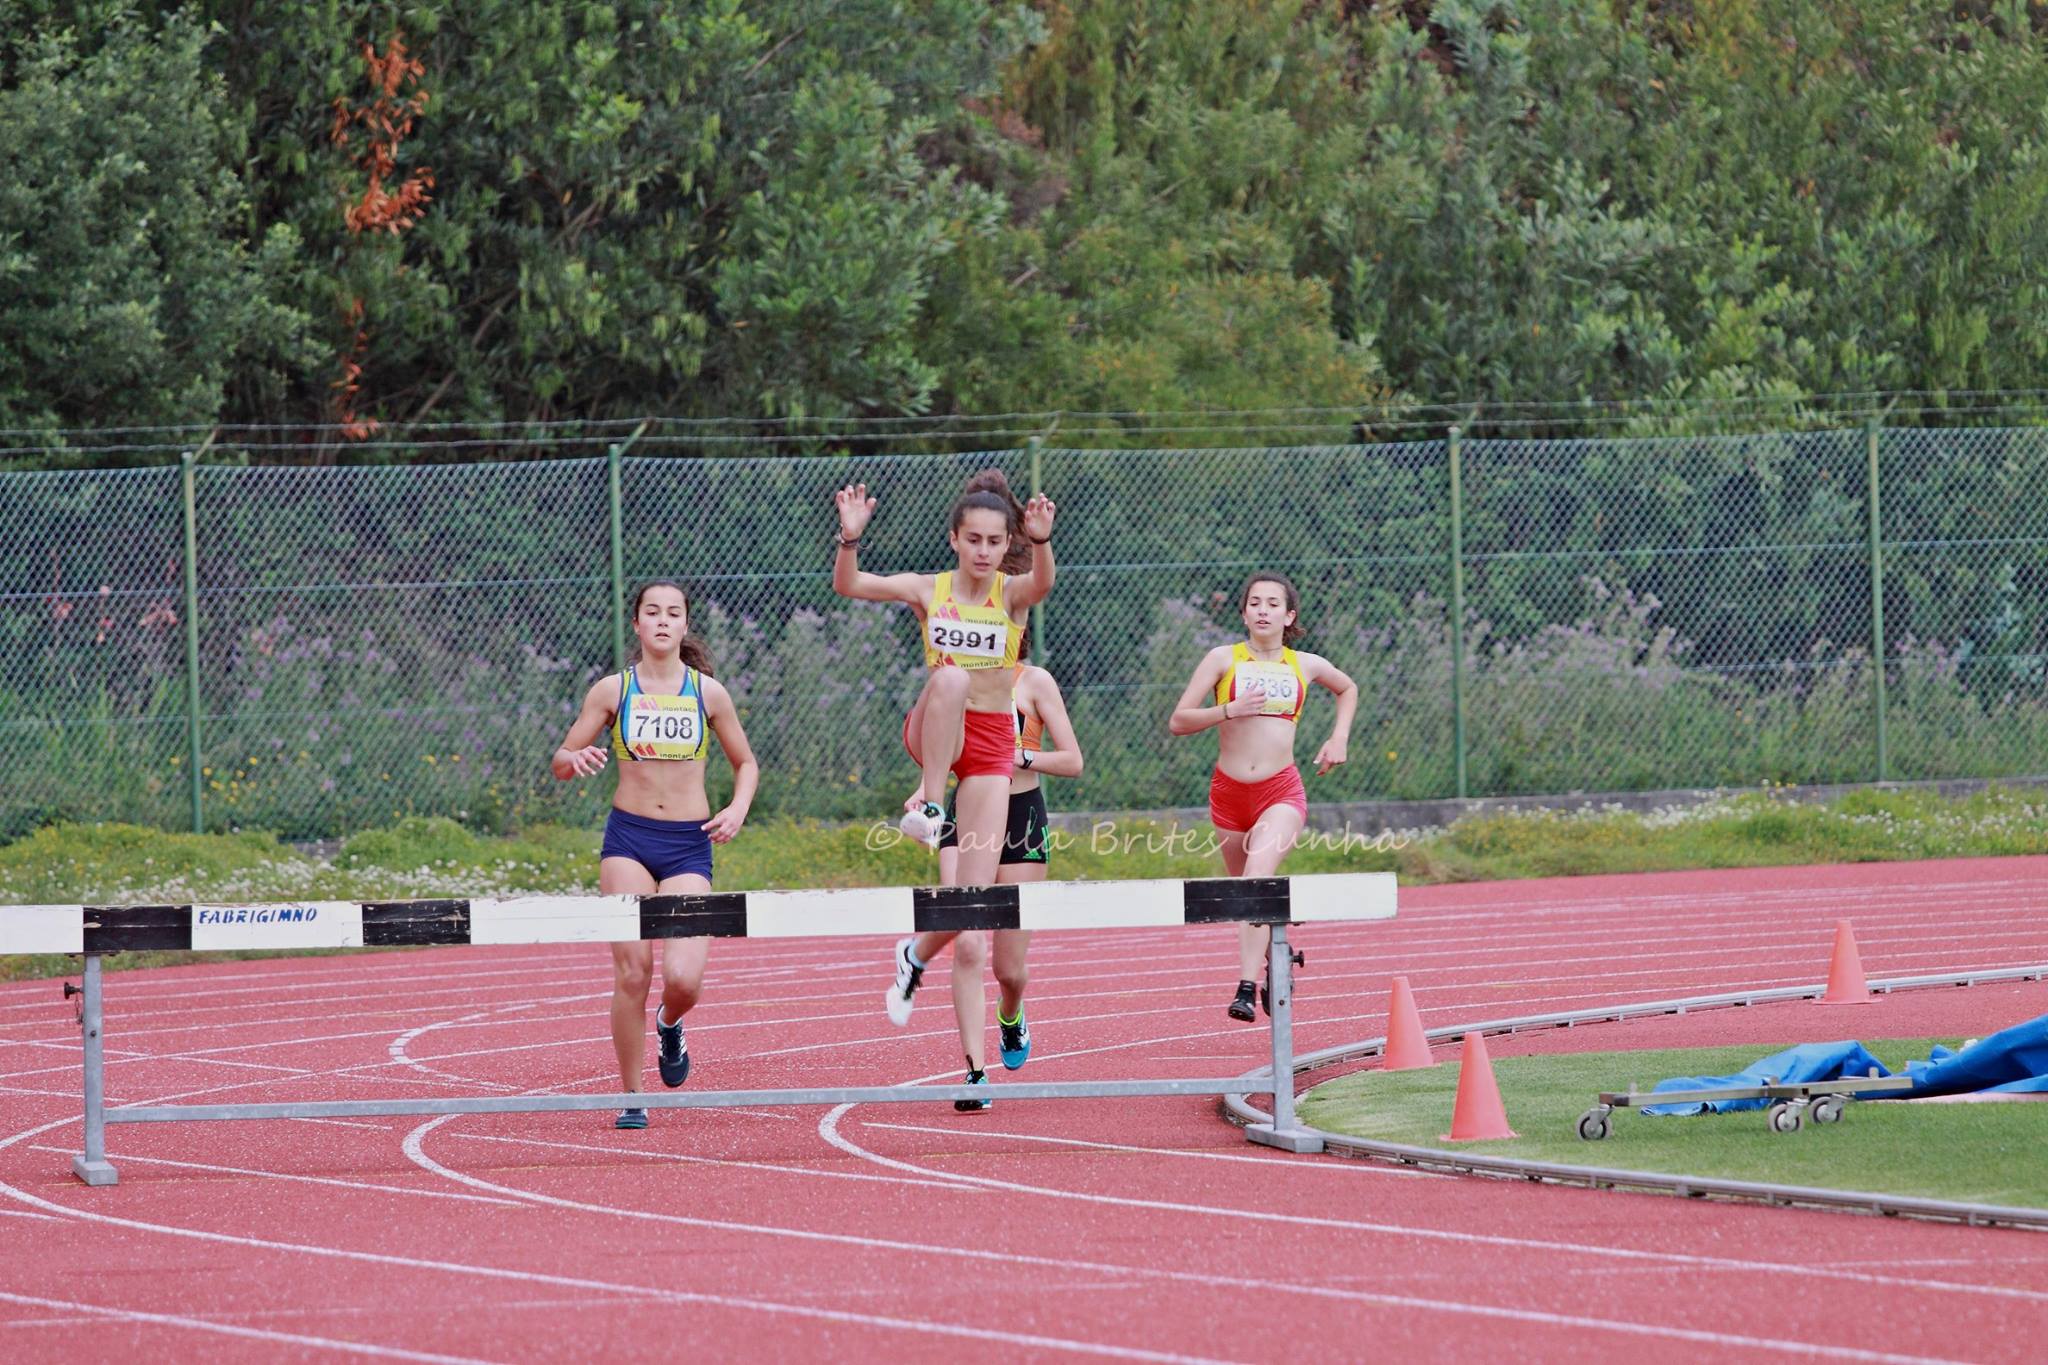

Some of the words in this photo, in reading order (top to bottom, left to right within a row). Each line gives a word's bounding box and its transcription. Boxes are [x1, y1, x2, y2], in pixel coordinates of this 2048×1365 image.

[934, 627, 996, 650] 2991
[635, 715, 693, 739] 7108
[199, 907, 318, 924] FABRIGIMNO
